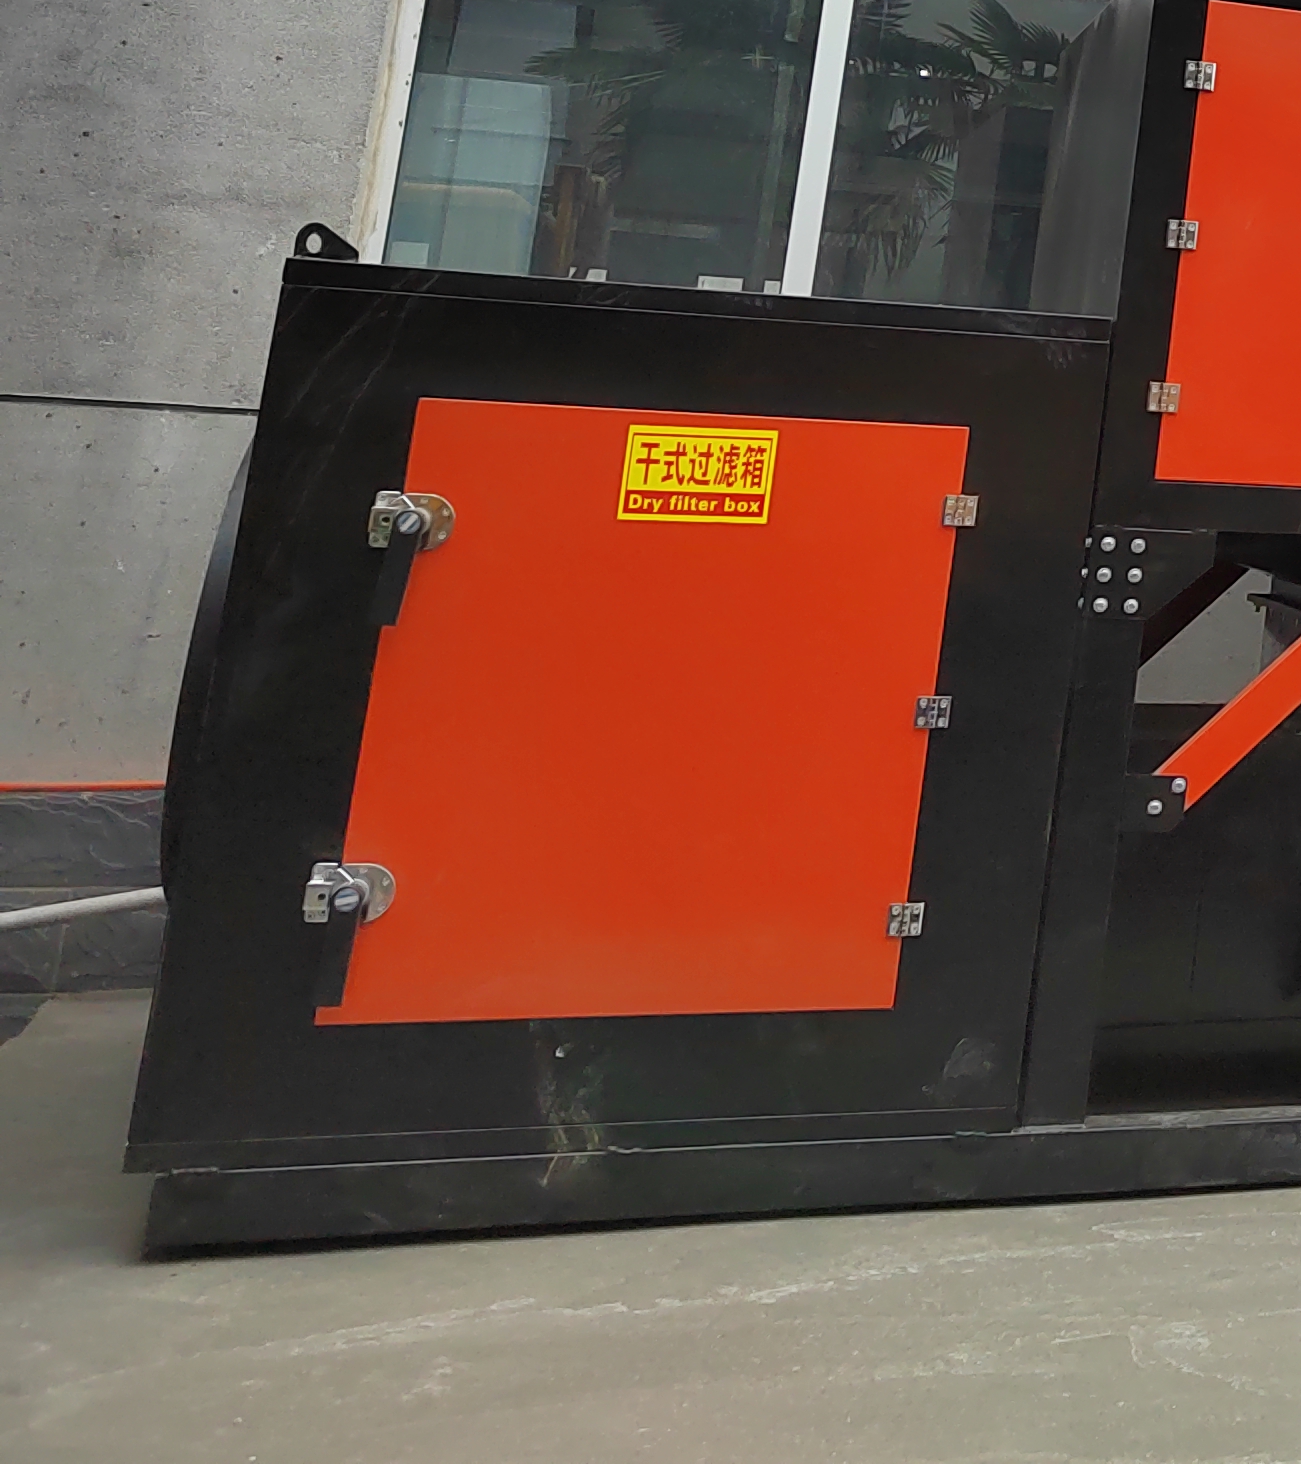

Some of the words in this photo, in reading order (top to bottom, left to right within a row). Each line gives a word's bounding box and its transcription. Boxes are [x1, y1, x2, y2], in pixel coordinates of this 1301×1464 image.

[635, 441, 768, 489] 干式过滤箱
[628, 493, 664, 513] Dry
[669, 494, 718, 512] filter
[723, 496, 760, 513] box
